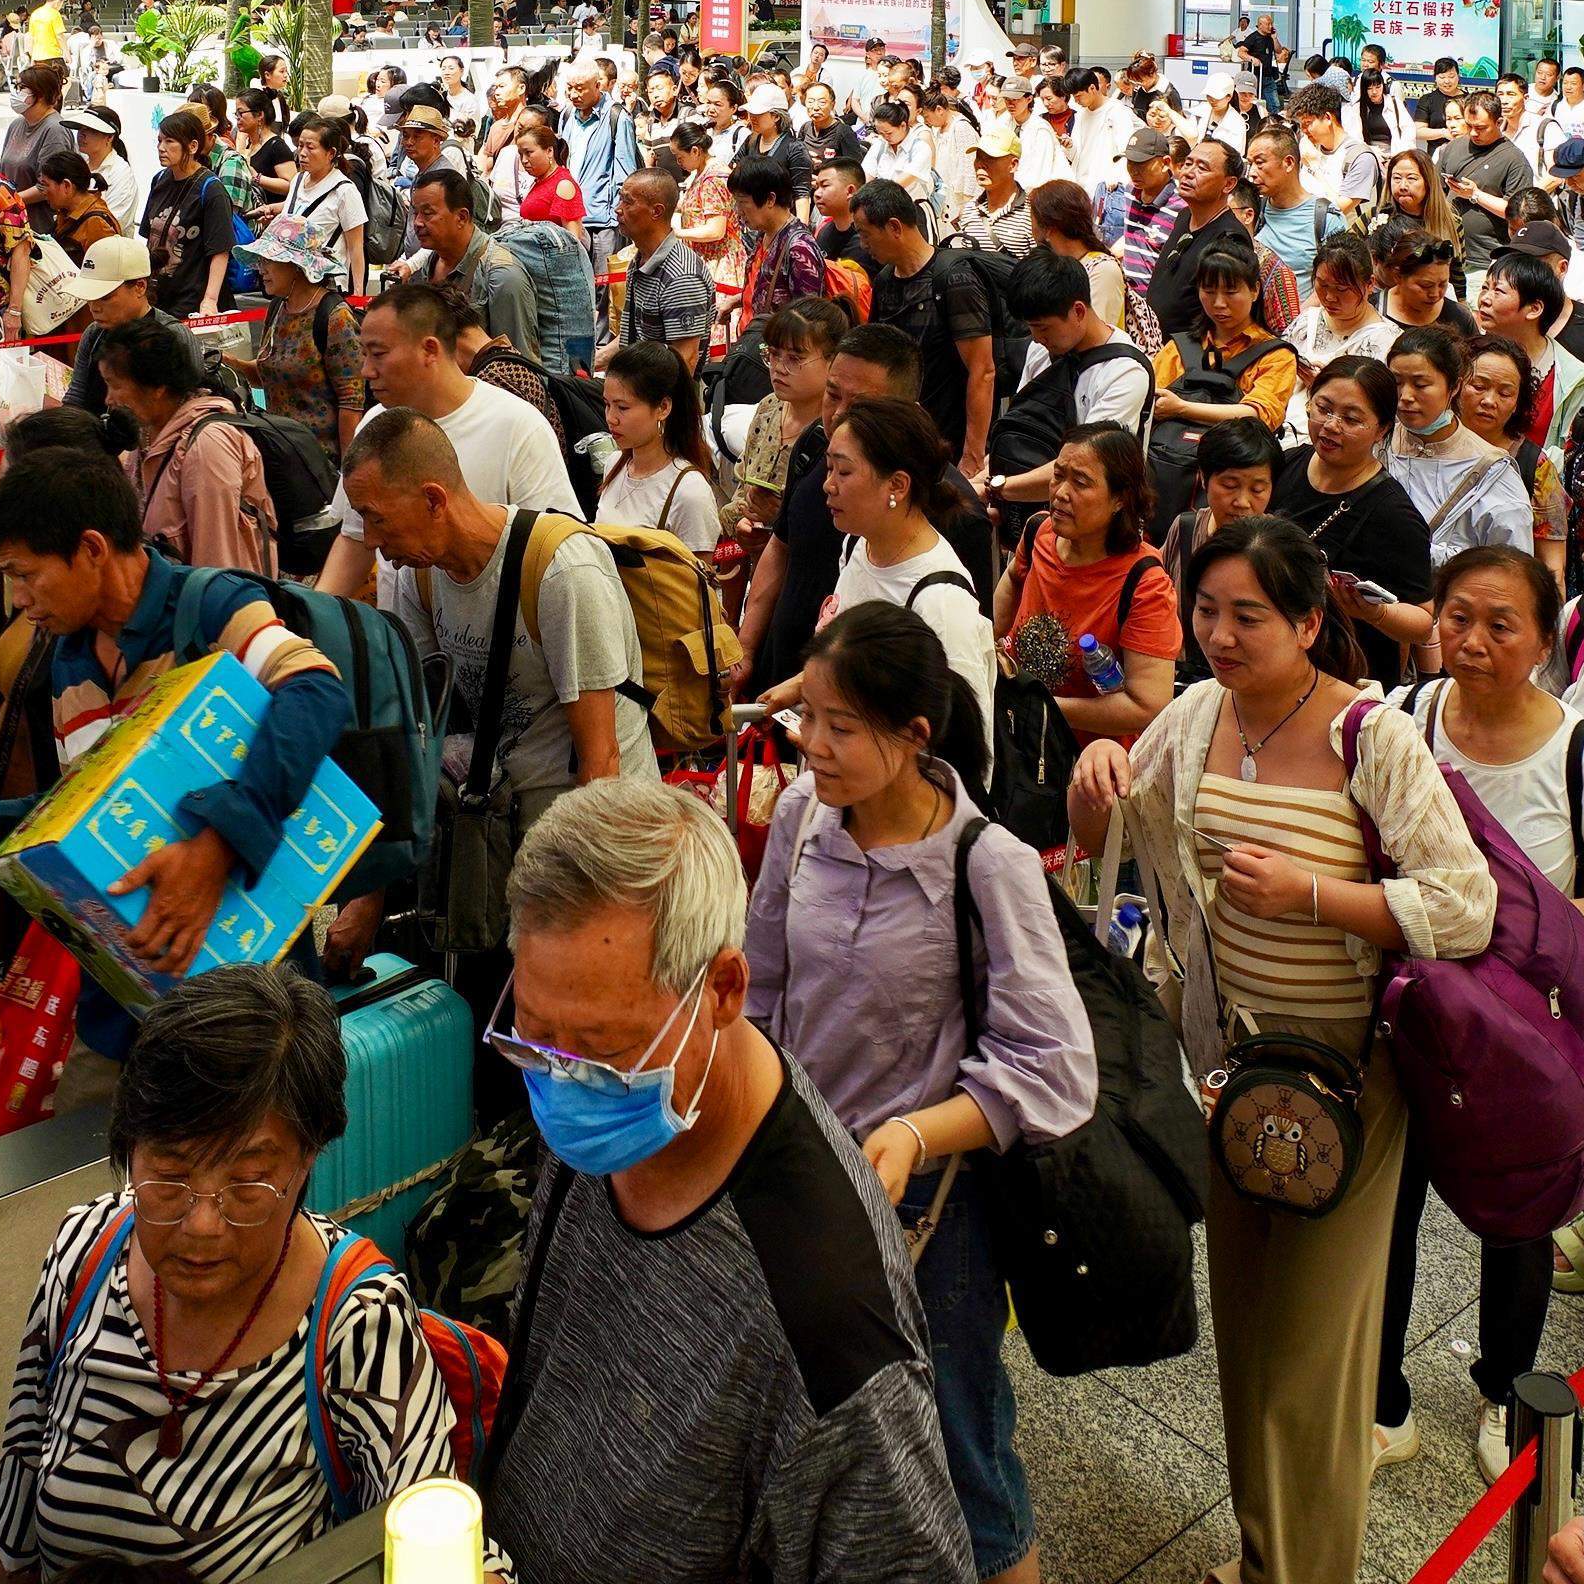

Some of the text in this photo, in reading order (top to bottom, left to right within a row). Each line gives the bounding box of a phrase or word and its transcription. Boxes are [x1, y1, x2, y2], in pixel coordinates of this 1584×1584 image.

[1373, 0, 1455, 17] 火红石榴籽
[1373, 20, 1455, 38] 民族一家亲
[1517, 227, 1528, 237] C
